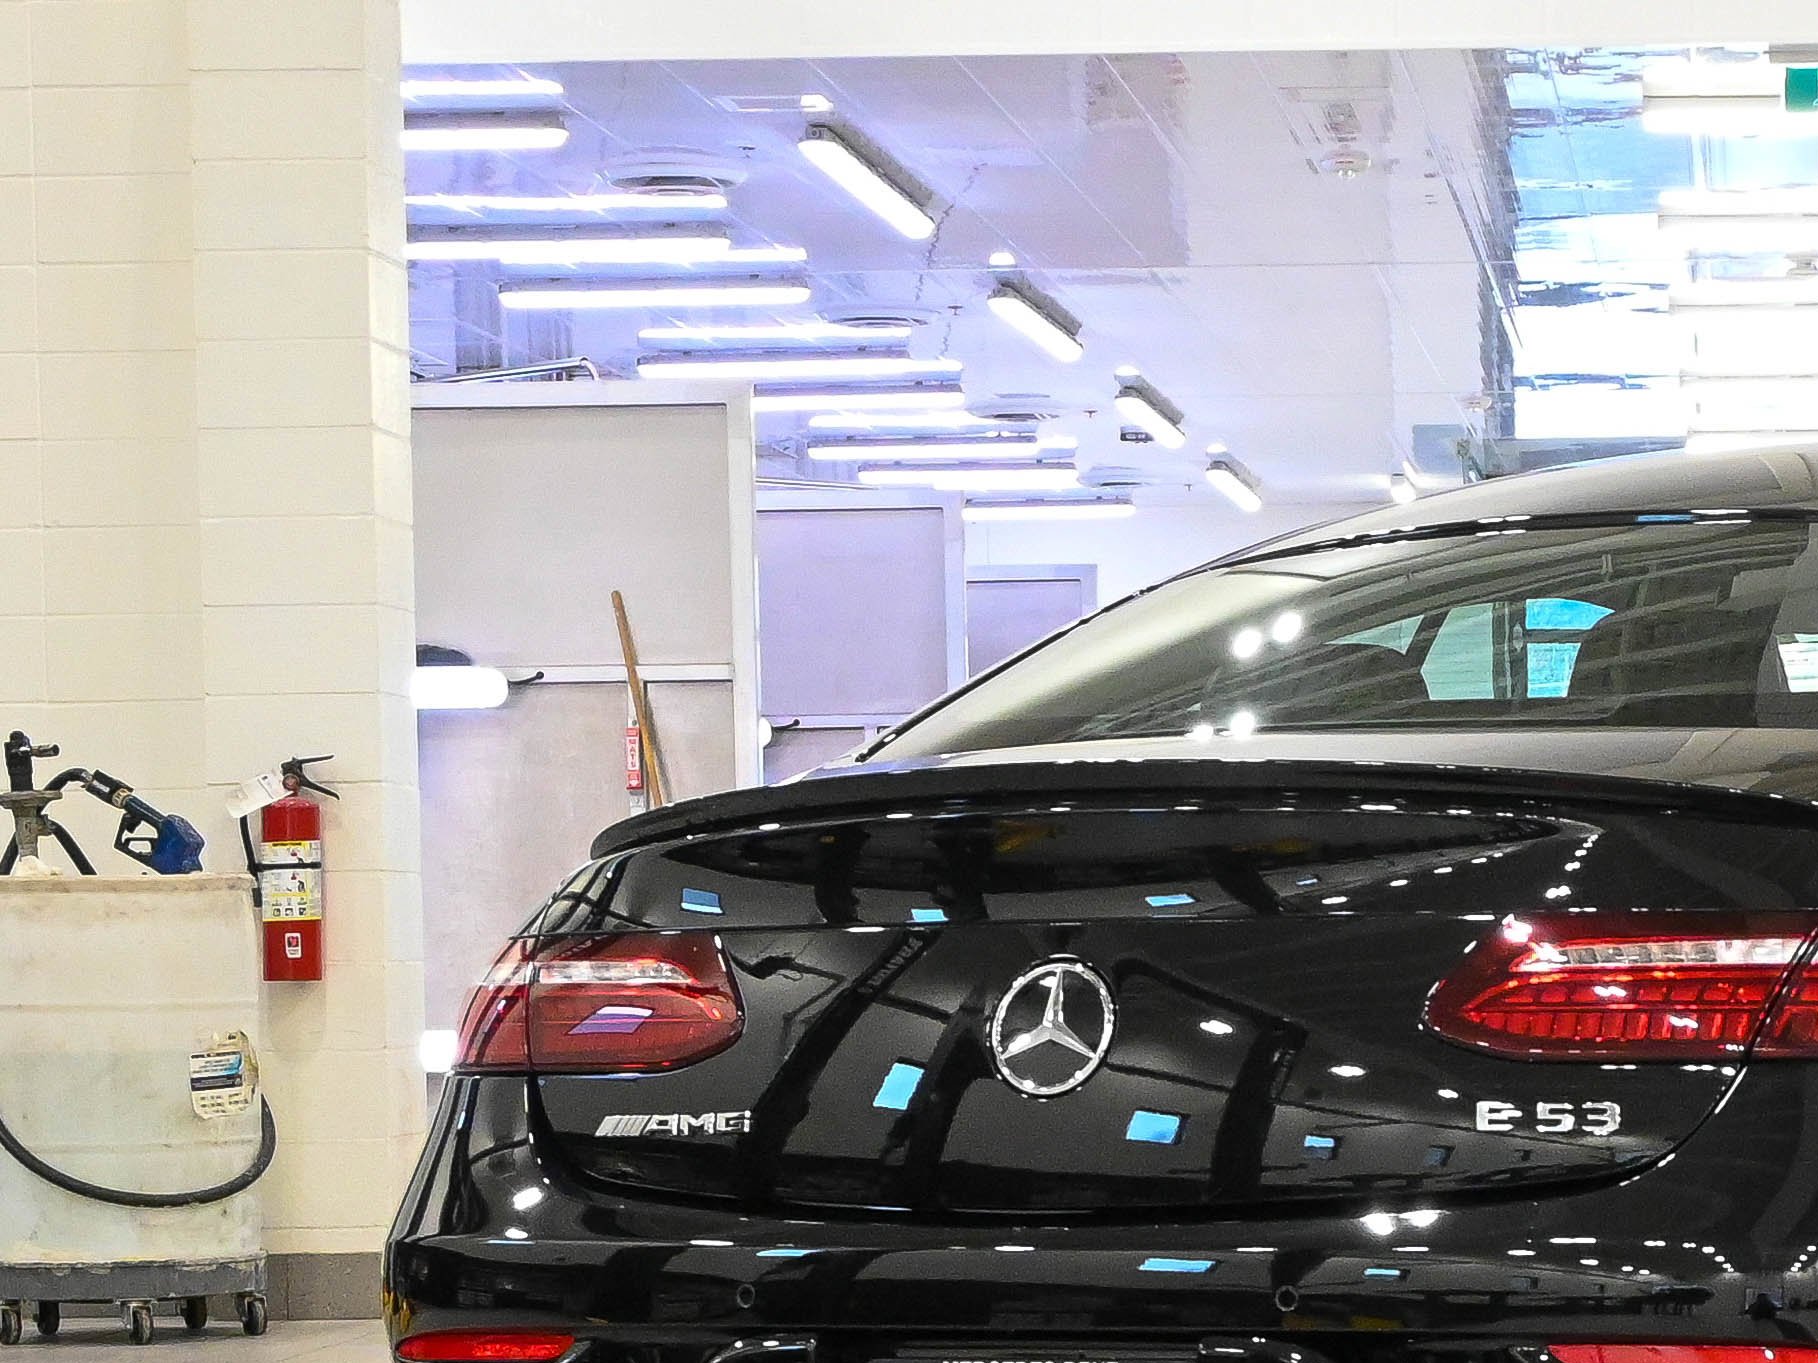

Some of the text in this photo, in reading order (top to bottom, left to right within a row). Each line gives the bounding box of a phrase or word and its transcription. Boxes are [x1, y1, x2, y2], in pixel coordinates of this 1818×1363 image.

[643, 1110, 752, 1136] AMG
[1476, 1101, 1621, 1135] E 53
